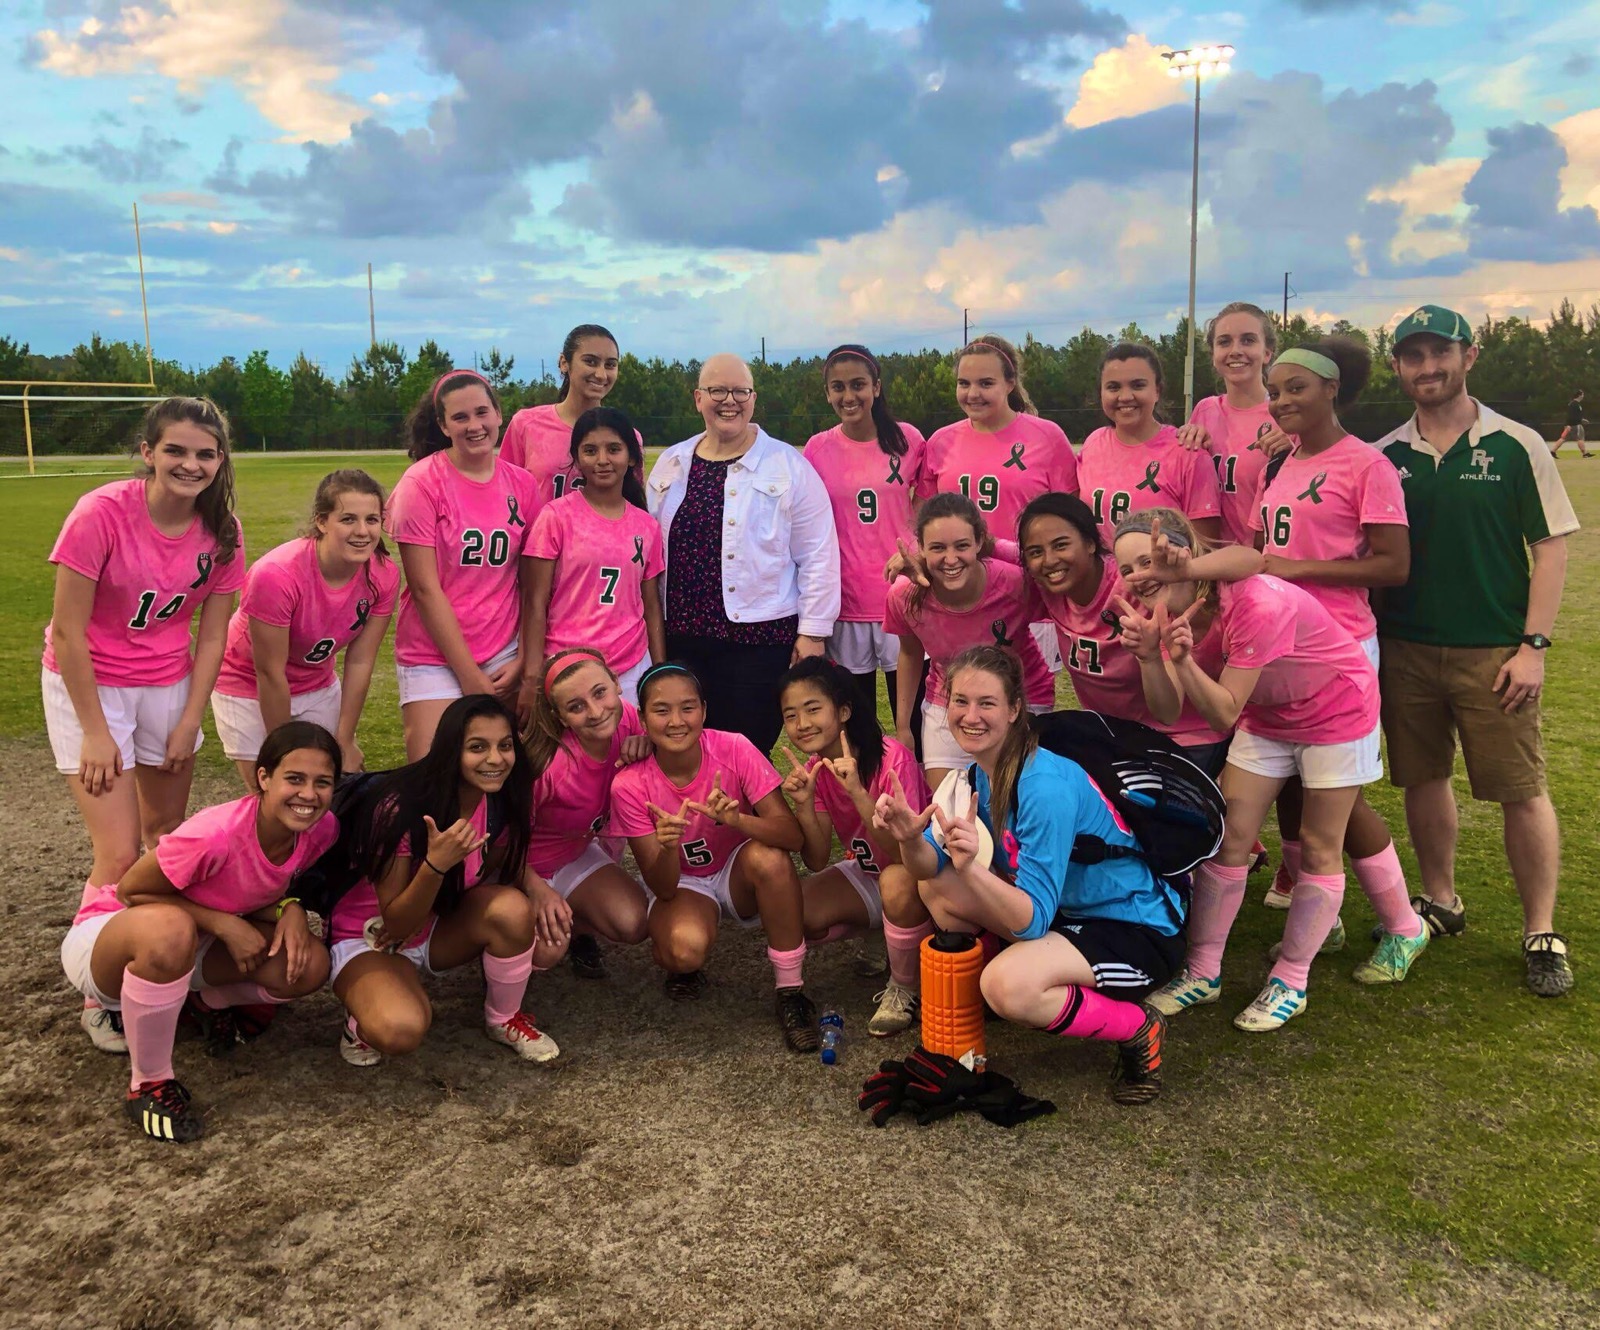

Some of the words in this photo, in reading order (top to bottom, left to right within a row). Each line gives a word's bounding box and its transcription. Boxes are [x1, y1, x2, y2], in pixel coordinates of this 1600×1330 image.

[1459, 473, 1501, 481] ATHLETICS
[1470, 450, 1494, 474] RT
[857, 488, 878, 524] 9
[958, 474, 1000, 513] 19
[1092, 488, 1132, 526] 18
[1261, 504, 1292, 548] 16
[460, 528, 510, 567] 20
[600, 567, 620, 605] 7
[128, 590, 186, 630] 14
[304, 637, 336, 664] 8
[1063, 631, 1104, 676] 17
[681, 838, 714, 867] 5
[851, 838, 882, 874] 2
